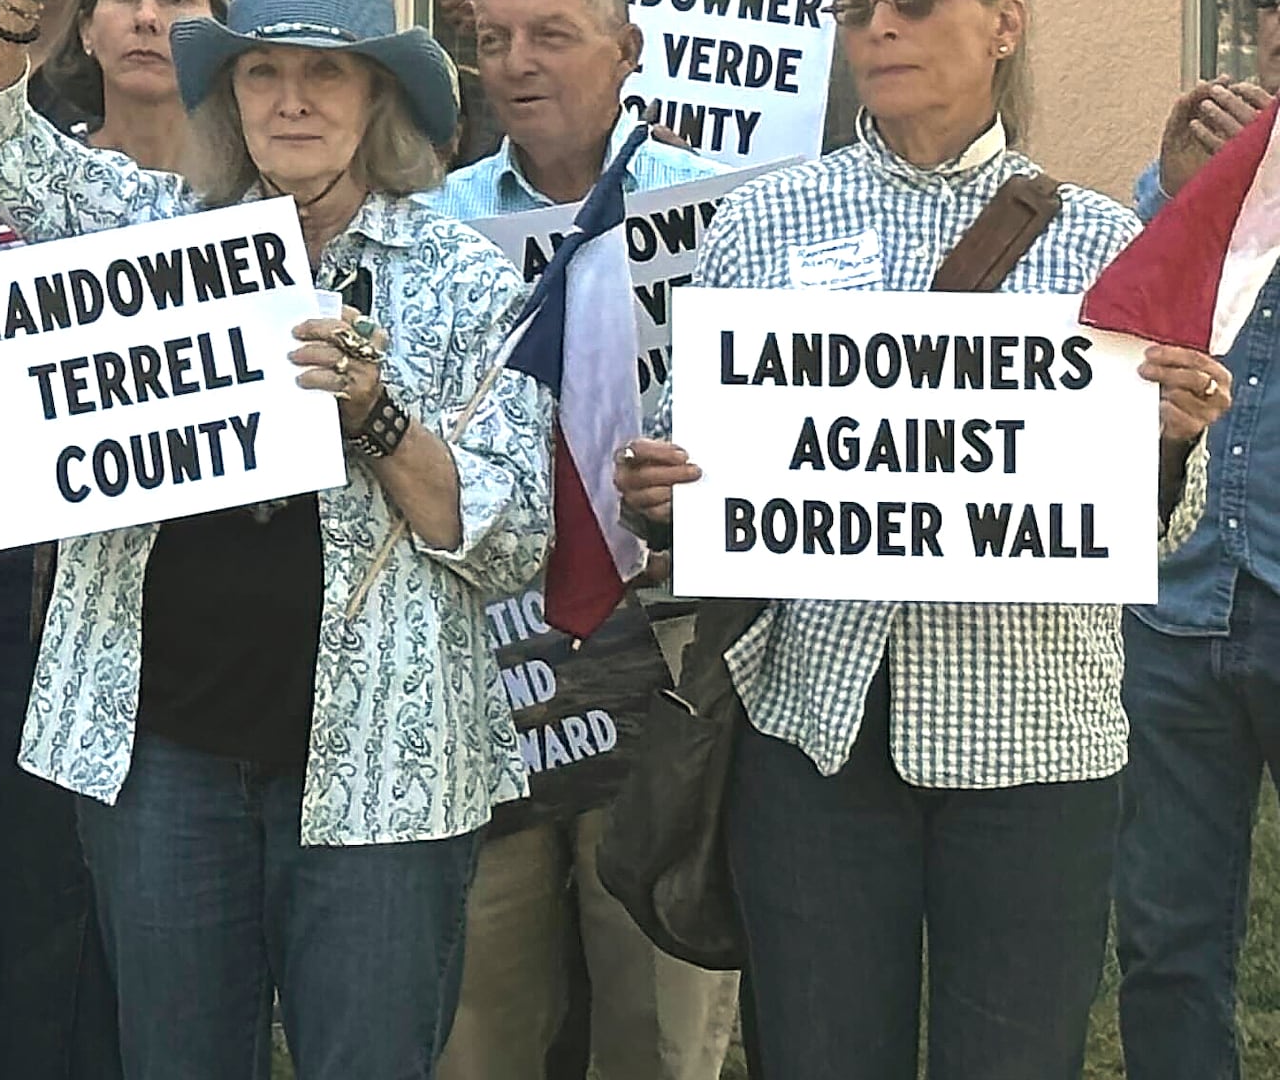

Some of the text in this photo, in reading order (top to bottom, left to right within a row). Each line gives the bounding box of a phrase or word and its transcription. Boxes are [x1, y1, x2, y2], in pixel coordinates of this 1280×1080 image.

[663, 32, 803, 94] VERDE
[28, 327, 264, 420] TERRELL
[720, 331, 1093, 390] LANDOWNERS
[56, 412, 261, 503] COUNTY
[789, 416, 1025, 473] AGAINST
[724, 497, 1109, 558] BORDER WALL
